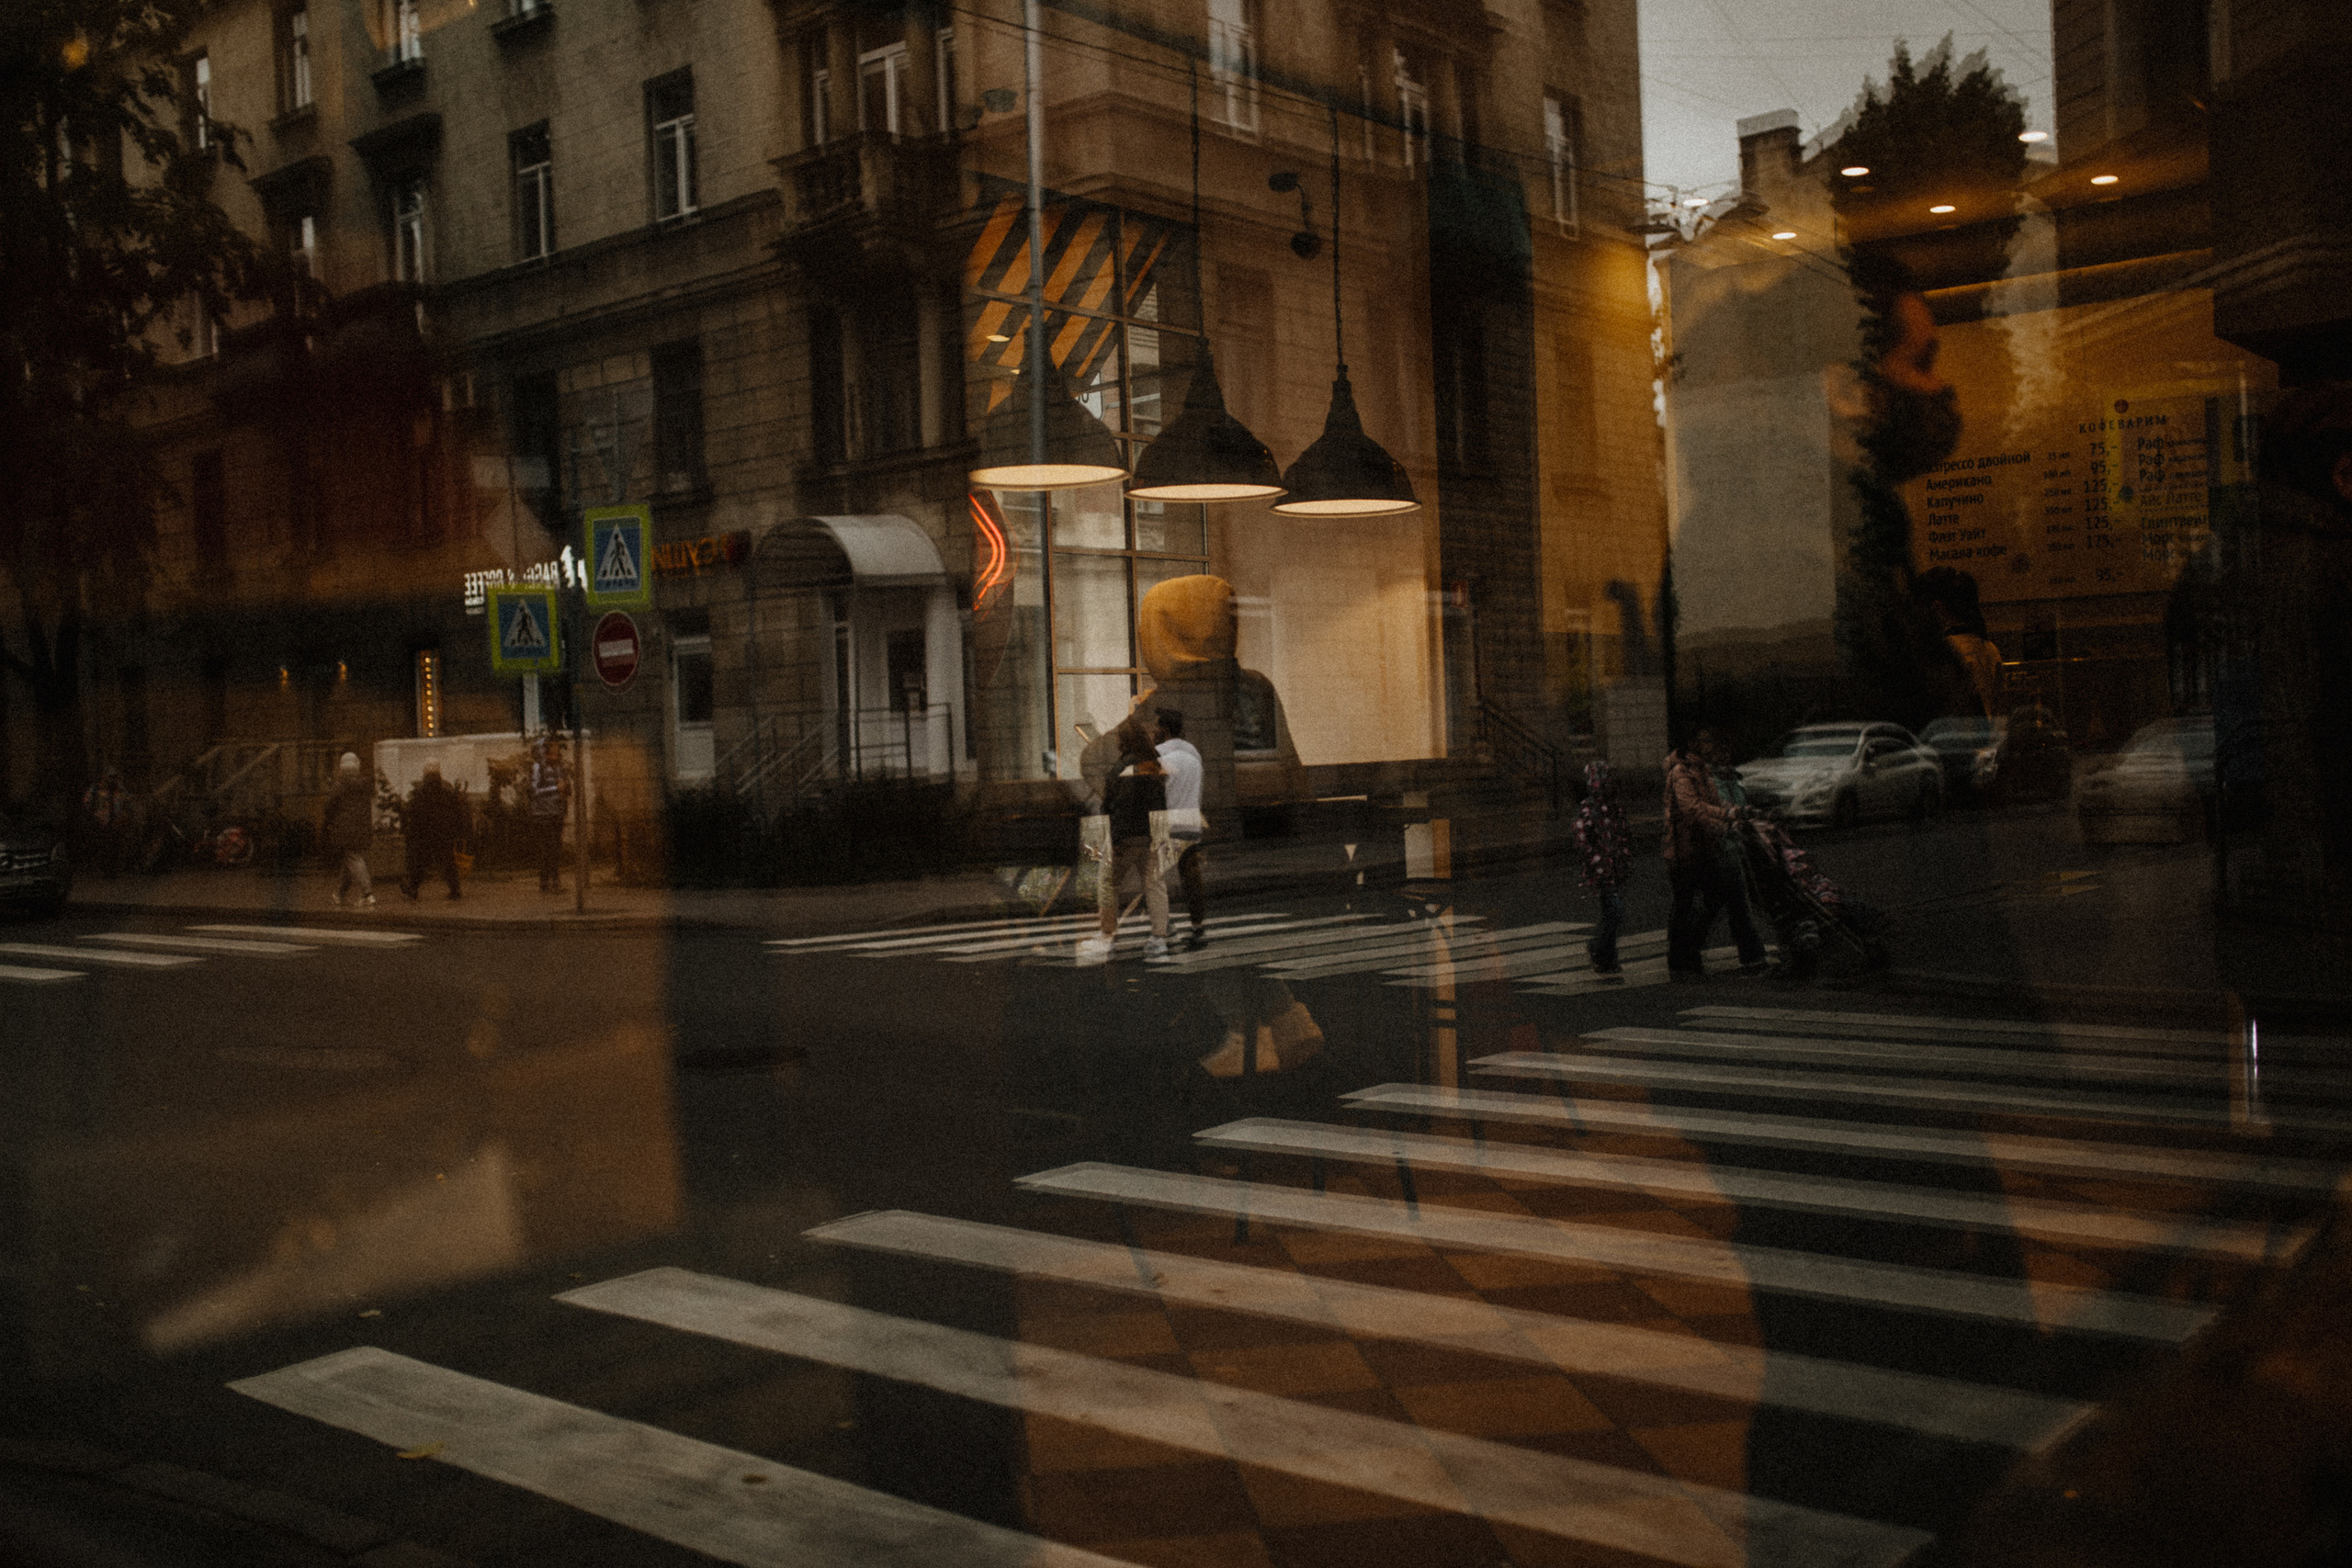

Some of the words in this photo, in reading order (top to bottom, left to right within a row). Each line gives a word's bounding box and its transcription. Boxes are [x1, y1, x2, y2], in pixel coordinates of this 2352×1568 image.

[2138, 434, 2165, 451] Раф
[1978, 451, 2030, 469] двойной
[2139, 451, 2165, 468] Раф
[1926, 475, 1993, 491] Американо
[2139, 467, 2165, 483] Раф
[1927, 493, 1984, 510] Капучино
[1928, 513, 1960, 526] Латте
[1928, 531, 1957, 543] Флэт
[1959, 527, 1986, 541] Уайт
[1929, 547, 1973, 562] Масала
[1975, 543, 2007, 558] кофе
